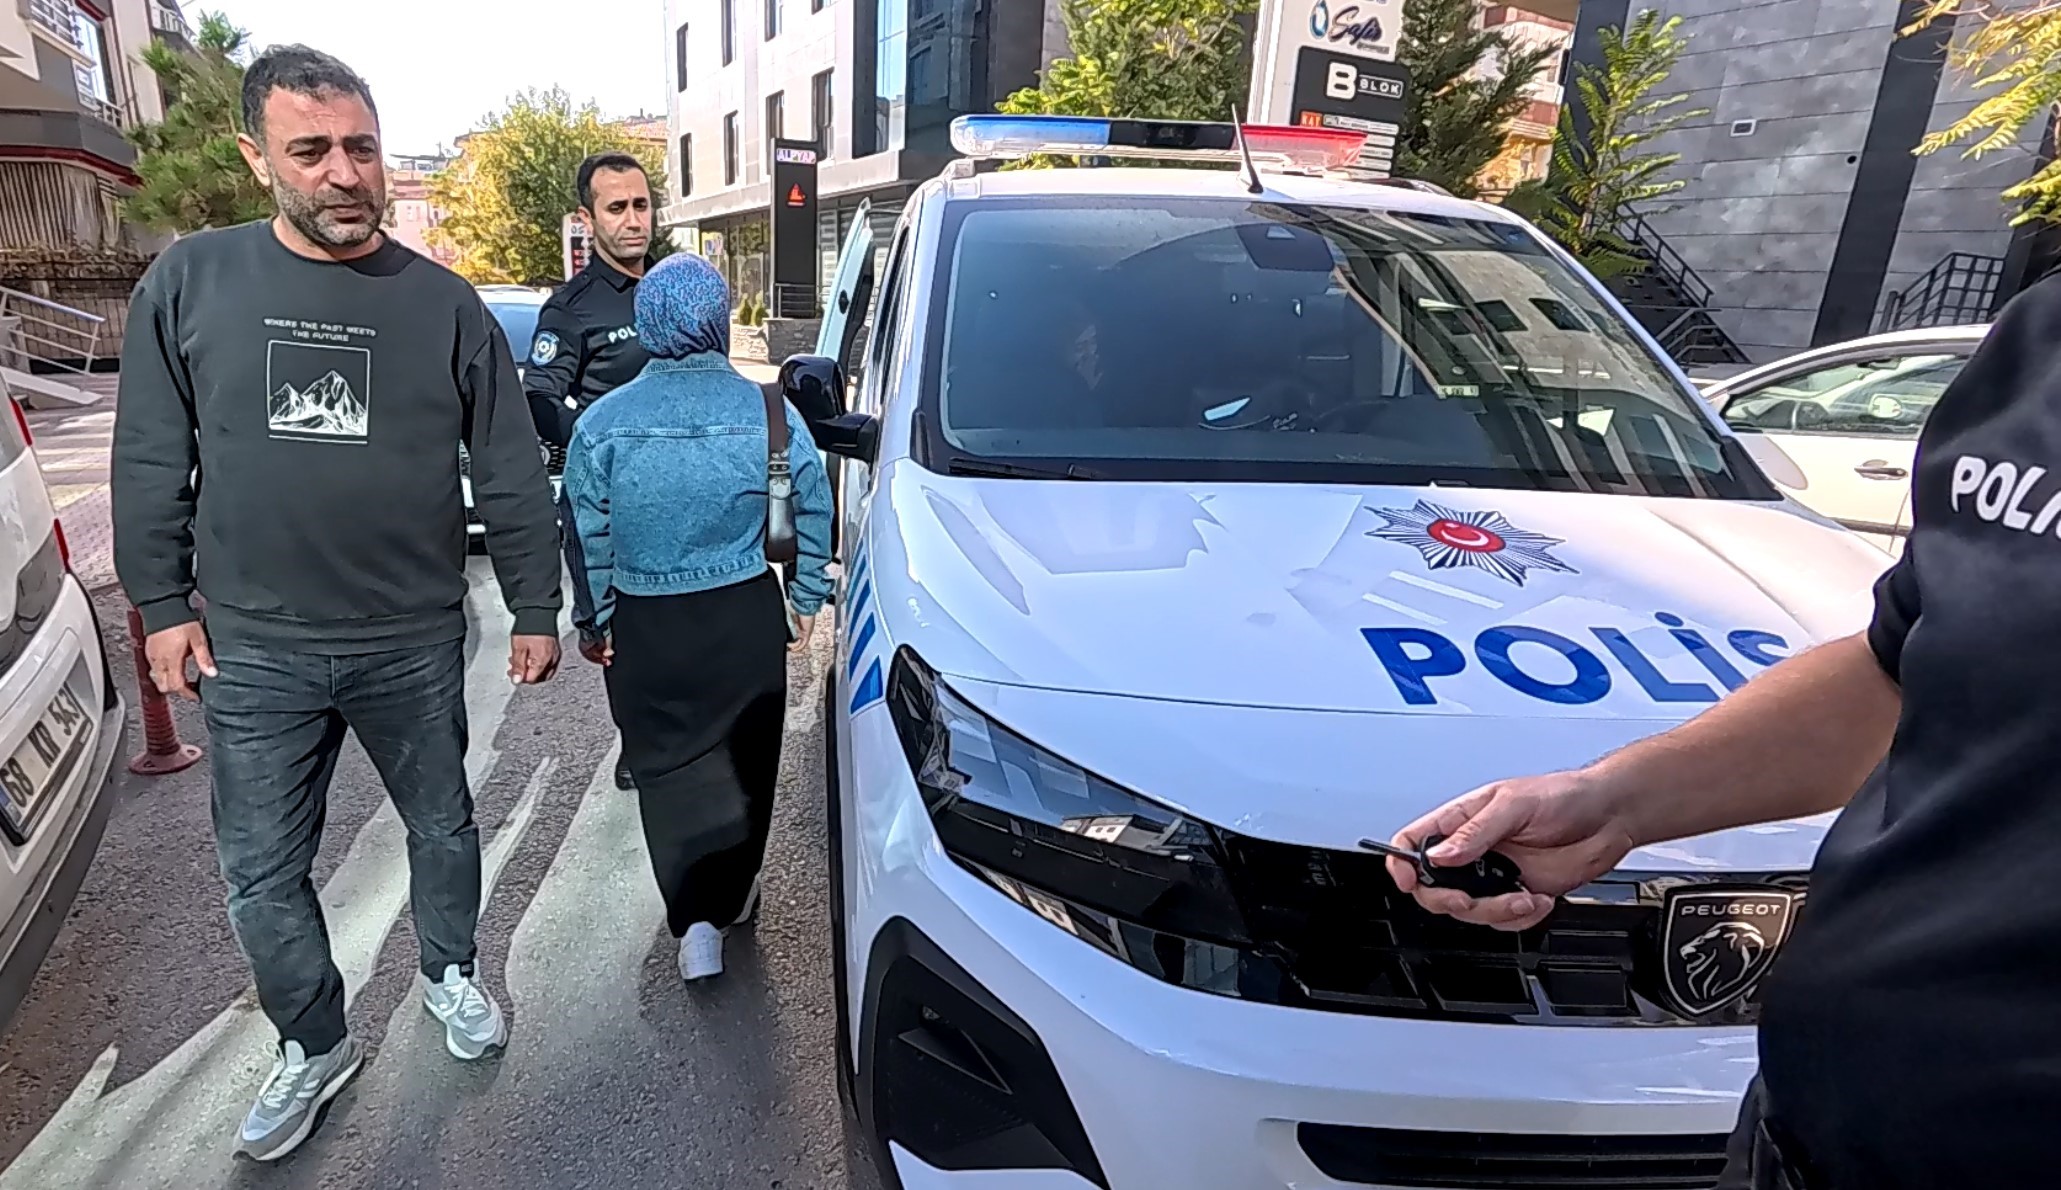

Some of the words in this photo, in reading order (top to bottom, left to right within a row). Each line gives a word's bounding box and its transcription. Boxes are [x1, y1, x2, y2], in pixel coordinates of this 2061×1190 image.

[1326, 61, 1357, 99] B
[1360, 78, 1400, 95] BLOK
[263, 318, 297, 328] WHERE
[300, 321, 318, 331] THE
[320, 323, 343, 333] PAST
[346, 326, 376, 337] MEETS
[292, 330, 309, 339] THE
[312, 332, 349, 342] FUTURE
[608, 326, 637, 343] POL
[0, 756, 34, 808] 68
[27, 720, 61, 769] KR
[1681, 904, 1781, 916] PEUGEOT
